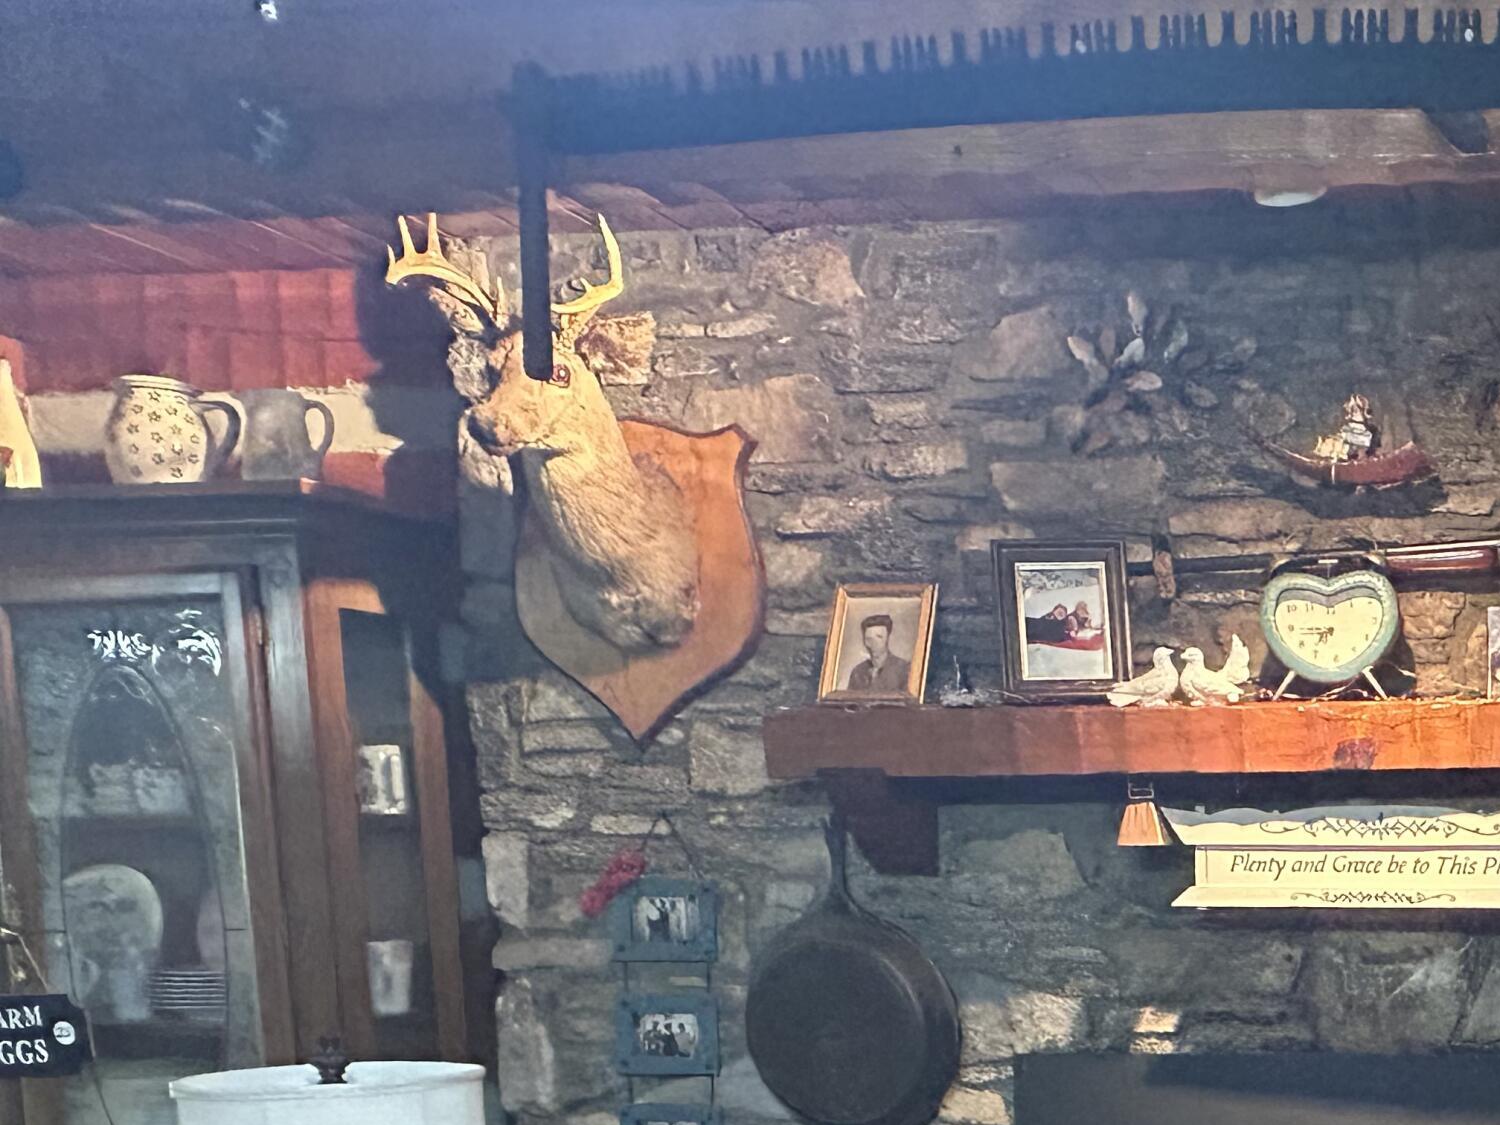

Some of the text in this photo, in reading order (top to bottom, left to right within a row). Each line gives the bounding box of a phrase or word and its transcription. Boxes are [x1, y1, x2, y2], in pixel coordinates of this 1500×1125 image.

[1230, 853, 1286, 881] Plenty
[1291, 854, 1327, 873] and
[1332, 855, 1383, 874] Grace
[1387, 854, 1408, 874] be
[1412, 857, 1430, 874] to
[1437, 854, 1478, 875] This
[0, 1005, 43, 1029] ARM
[0, 1039, 49, 1065] GGS
